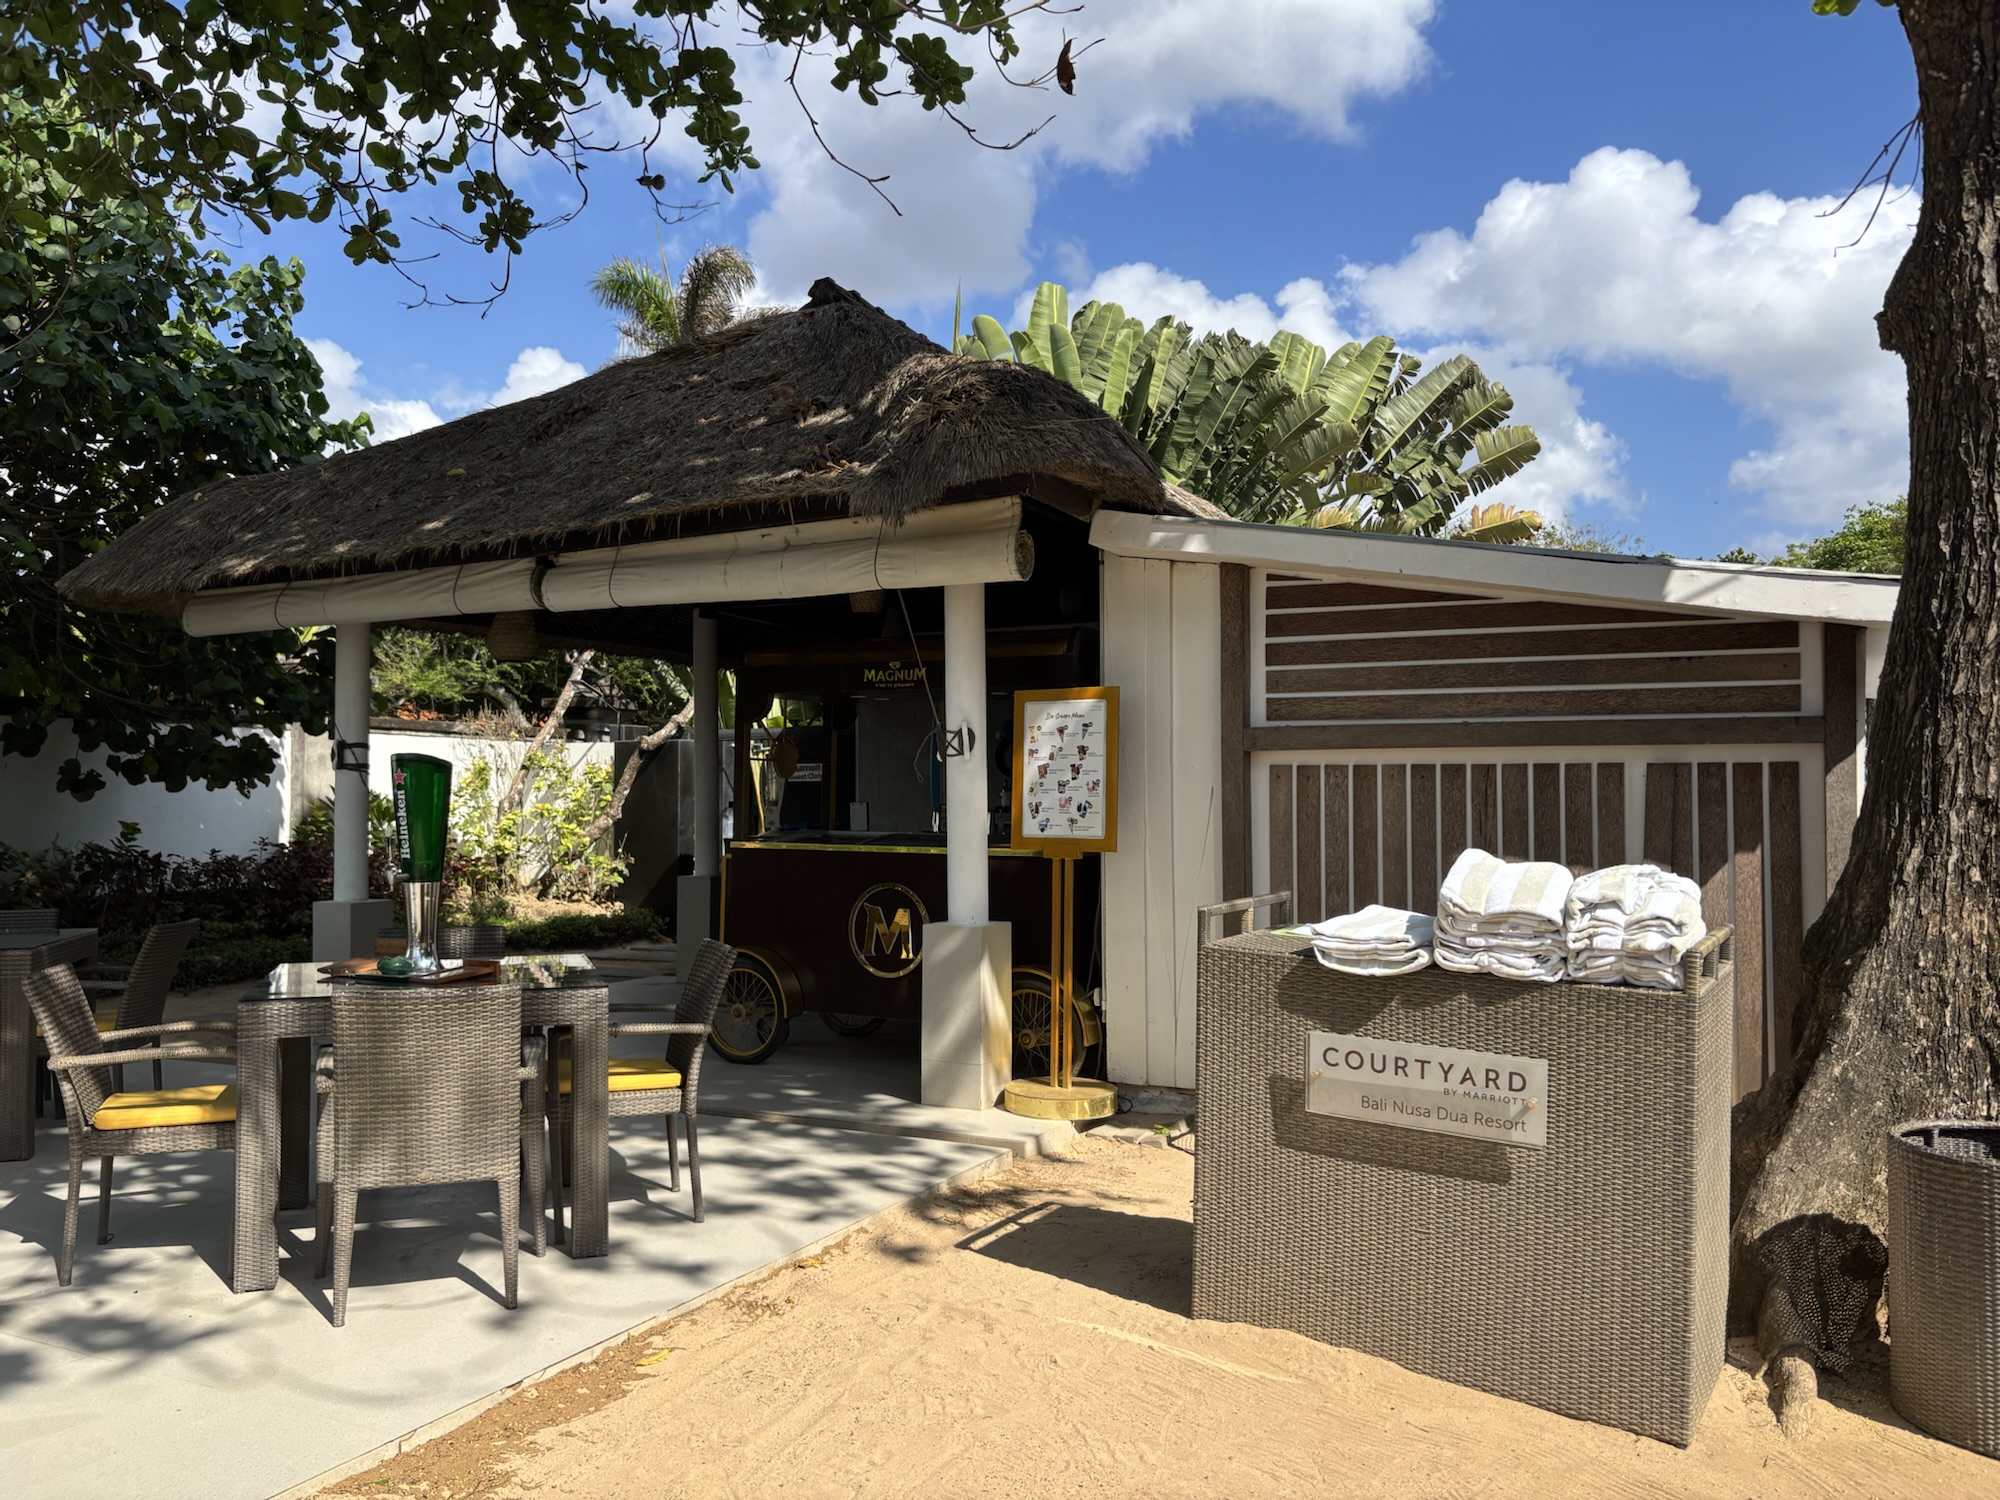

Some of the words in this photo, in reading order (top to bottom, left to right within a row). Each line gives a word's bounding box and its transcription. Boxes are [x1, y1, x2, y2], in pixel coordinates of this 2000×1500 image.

[863, 667, 927, 682] MAGNUM
[796, 764, 821, 772] arriott
[396, 789, 411, 859] Heineken
[863, 902, 915, 959] M
[1322, 1047, 1527, 1093] COURTYARD
[1361, 1095, 1388, 1111] Bali
[1393, 1100, 1431, 1118] Nusa
[1437, 1107, 1468, 1124] Dua
[1474, 1112, 1527, 1133] Resort
[1443, 1088, 1458, 1096] BY
[1463, 1091, 1527, 1106] MARRIOTT
